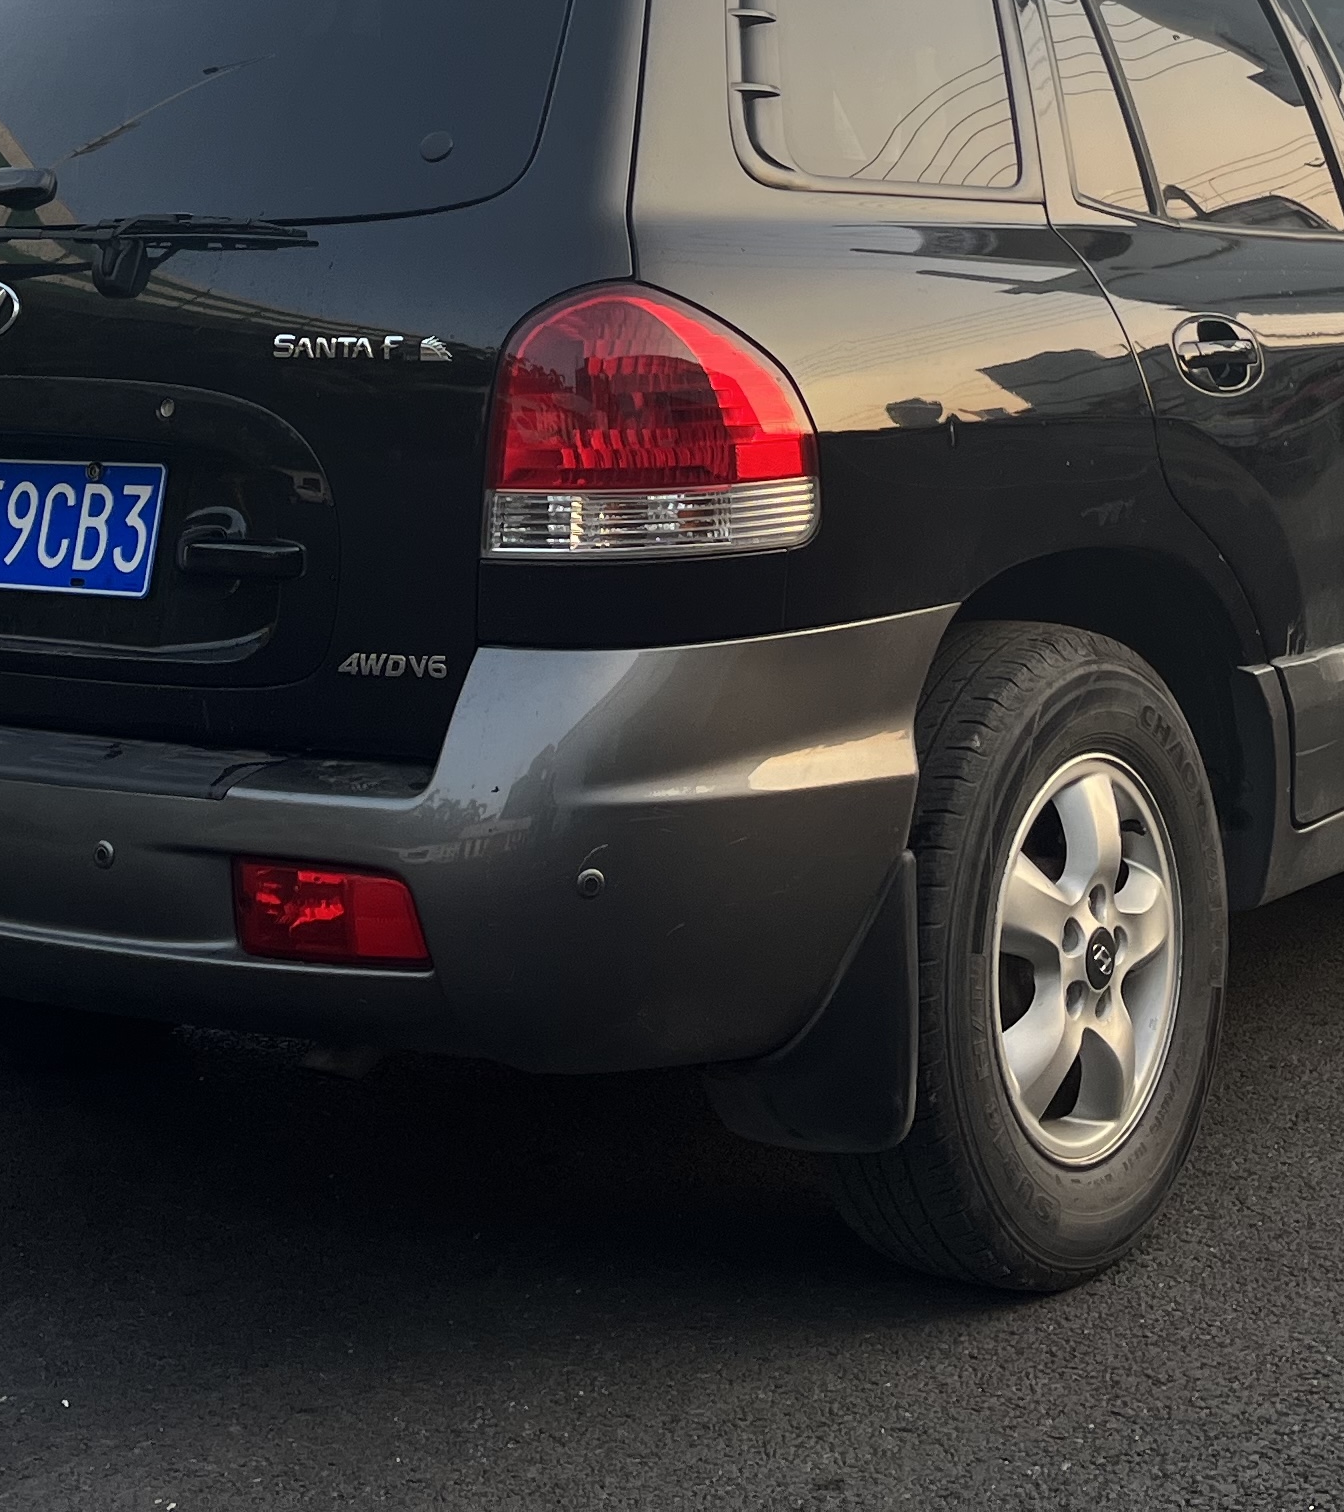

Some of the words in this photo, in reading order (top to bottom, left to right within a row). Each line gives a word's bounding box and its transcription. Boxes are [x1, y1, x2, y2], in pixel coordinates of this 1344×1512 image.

[273, 334, 374, 359] SANTA
[338, 652, 406, 677] 4WD
[408, 655, 447, 679] V6
